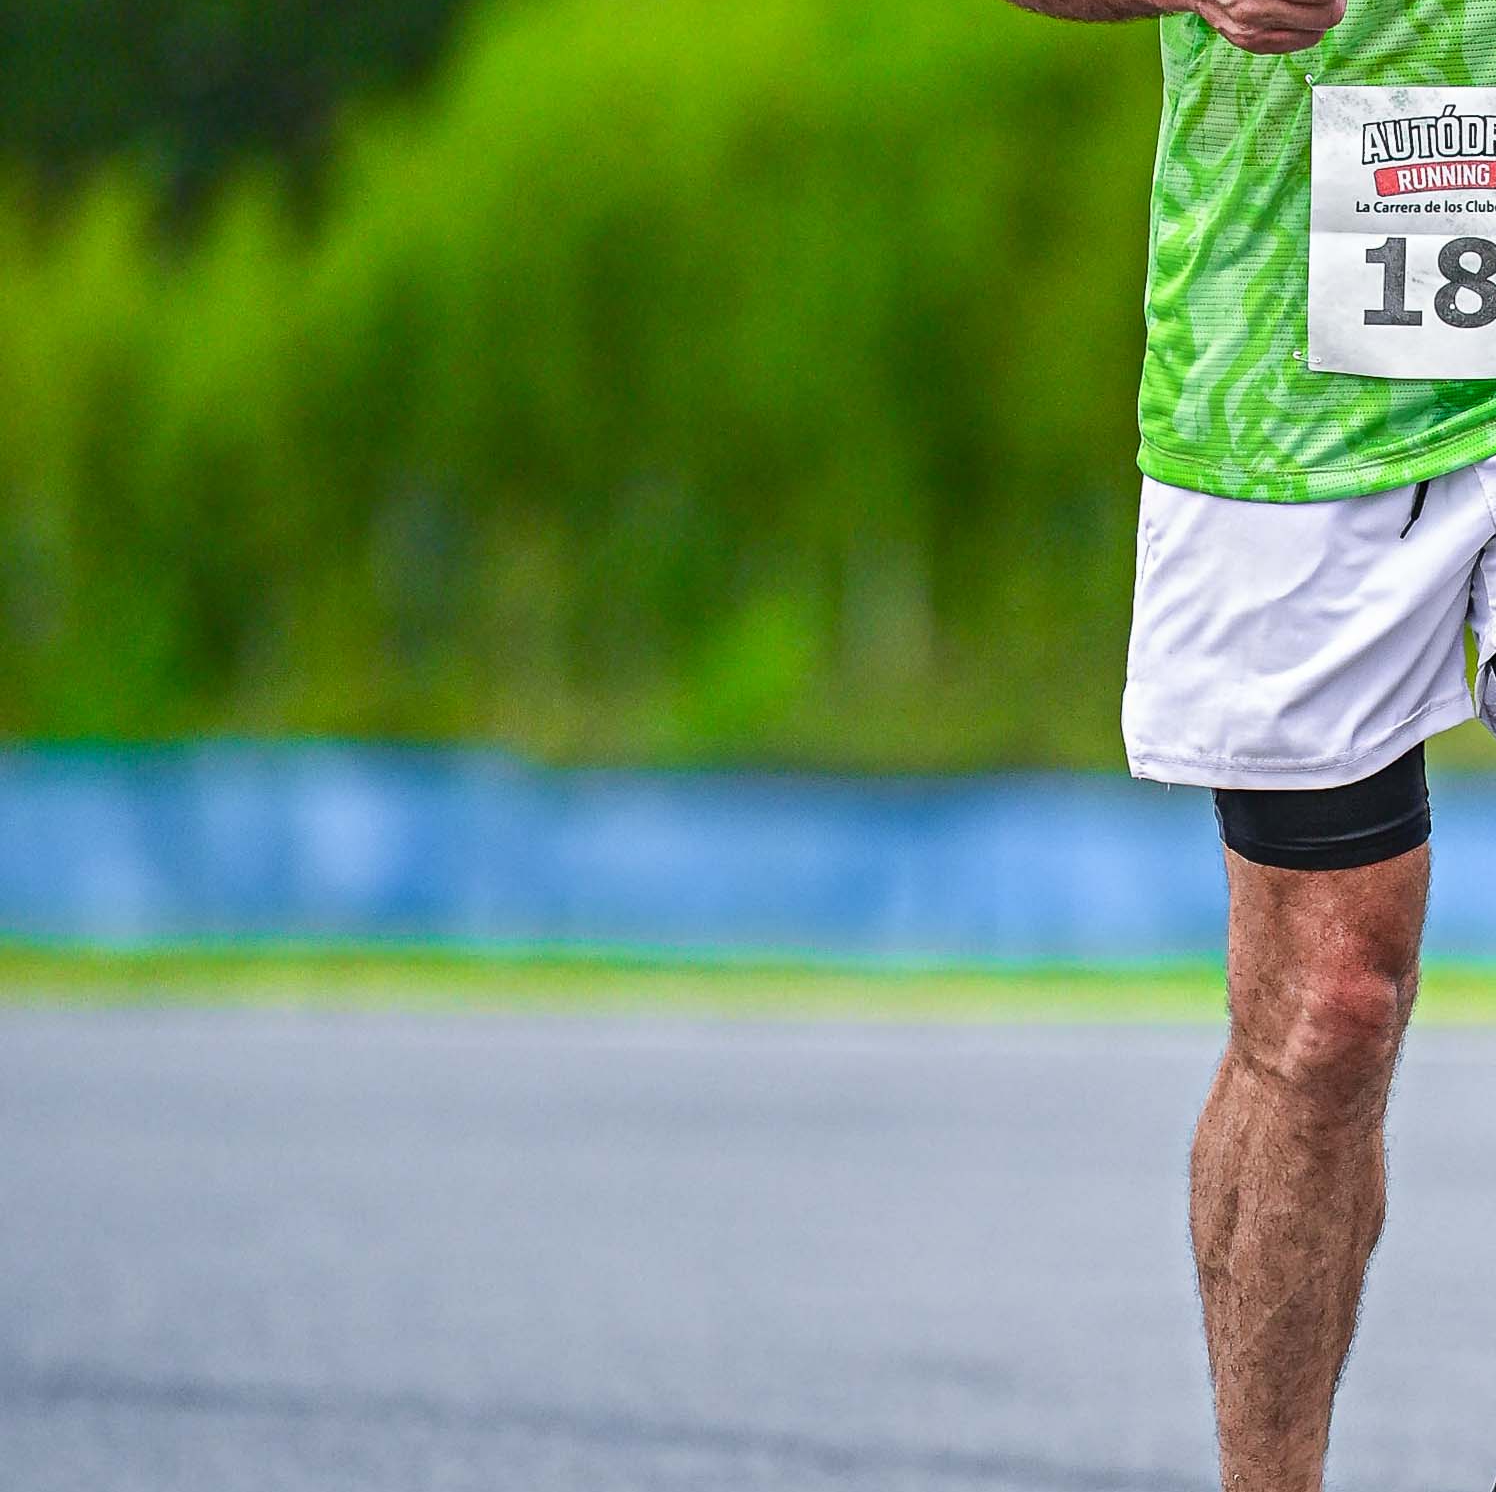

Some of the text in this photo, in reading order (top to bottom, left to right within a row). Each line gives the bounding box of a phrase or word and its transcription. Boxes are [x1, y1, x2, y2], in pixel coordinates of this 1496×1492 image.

[1396, 163, 1491, 192] RUNNING
[1356, 201, 1371, 213] La
[1373, 201, 1421, 214] Carrera
[1424, 199, 1441, 213] de
[1444, 199, 1463, 213] los
